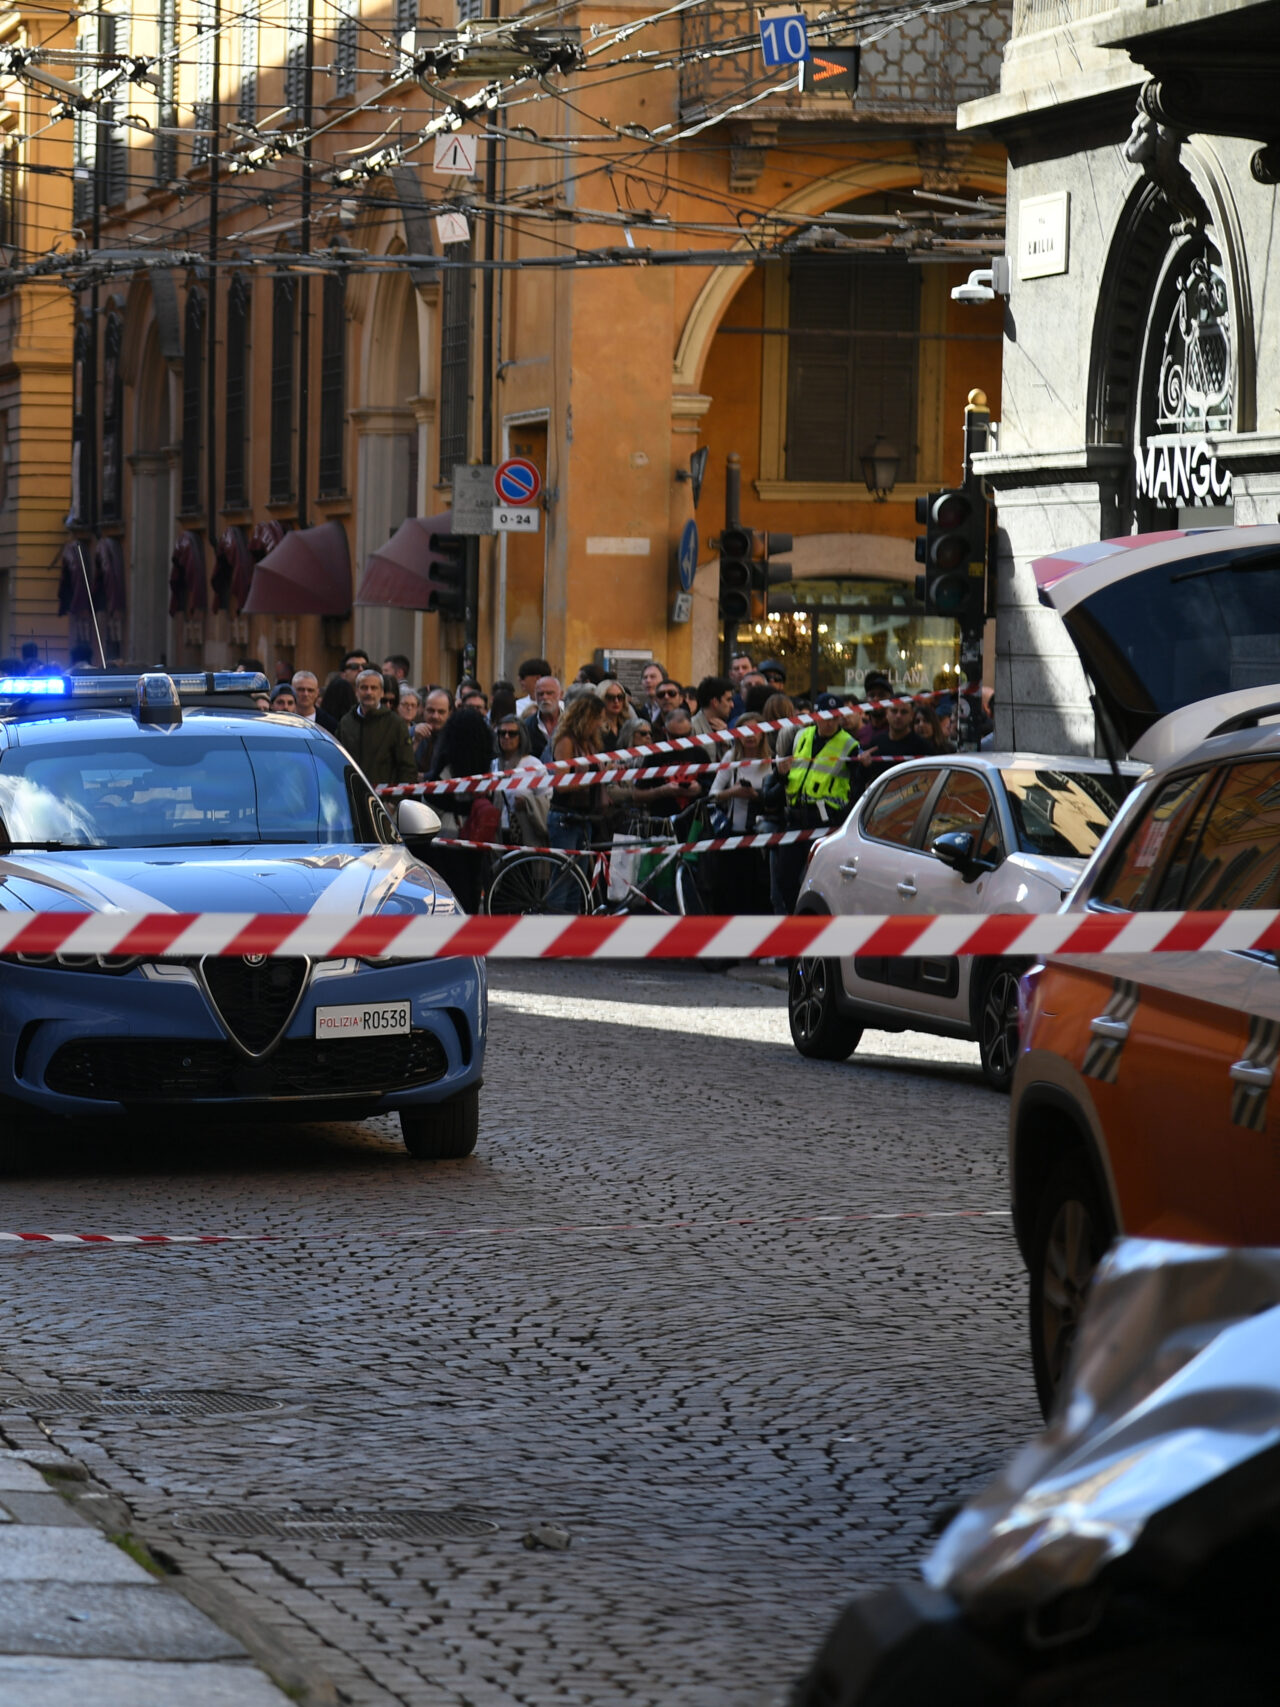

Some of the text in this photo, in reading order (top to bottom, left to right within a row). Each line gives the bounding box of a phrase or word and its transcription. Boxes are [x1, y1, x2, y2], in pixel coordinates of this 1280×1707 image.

[763, 19, 806, 61] 10
[847, 668, 929, 685] POLLANA
[319, 1016, 359, 1028] POLIZIA
